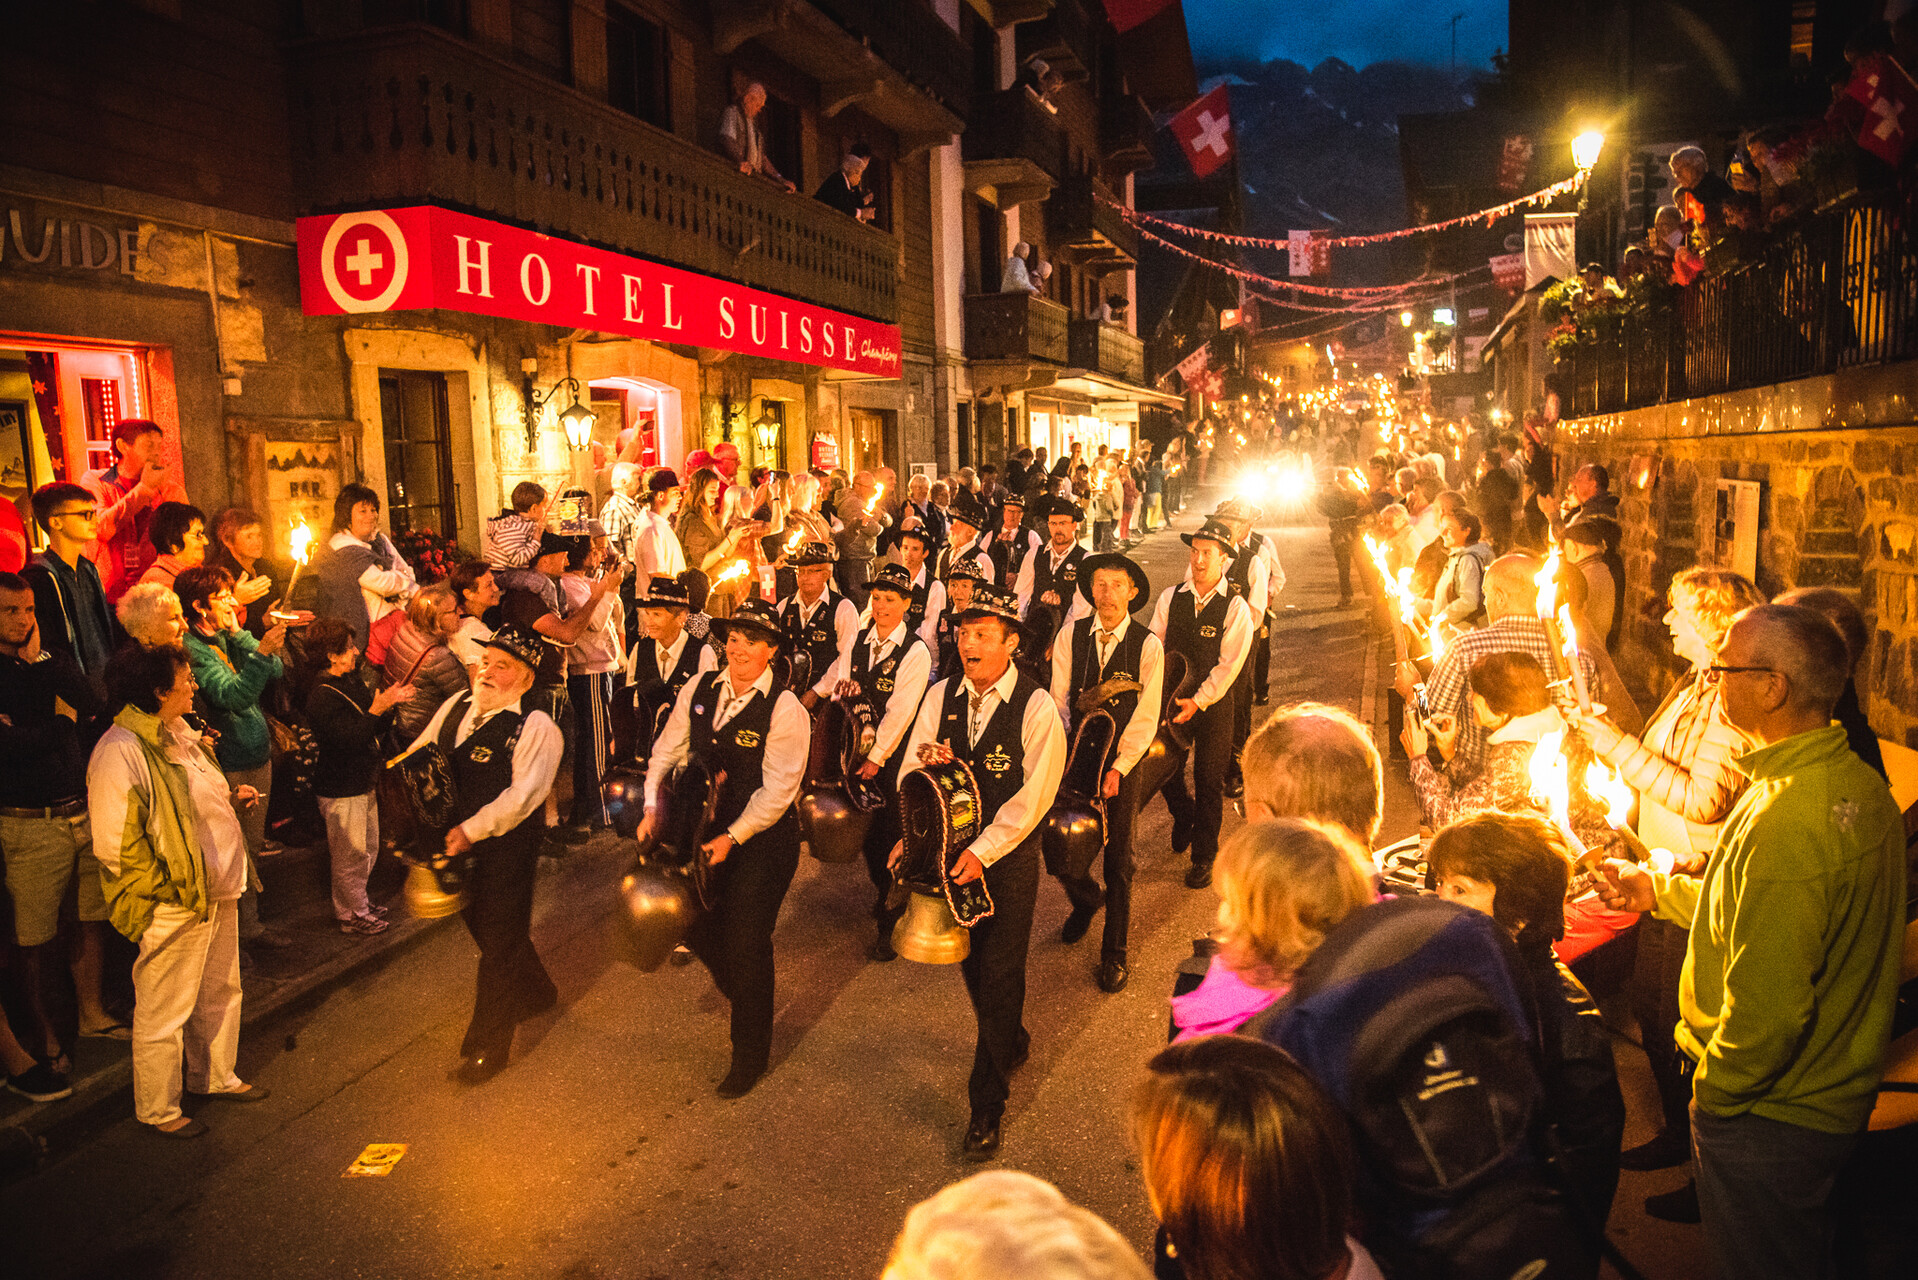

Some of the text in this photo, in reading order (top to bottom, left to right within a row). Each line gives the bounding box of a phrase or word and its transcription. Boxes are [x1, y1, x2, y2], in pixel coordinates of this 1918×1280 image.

[0, 209, 166, 277] UIDES
[453, 234, 856, 362] HOTEL SUISSE
[290, 481, 321, 498] BAR
